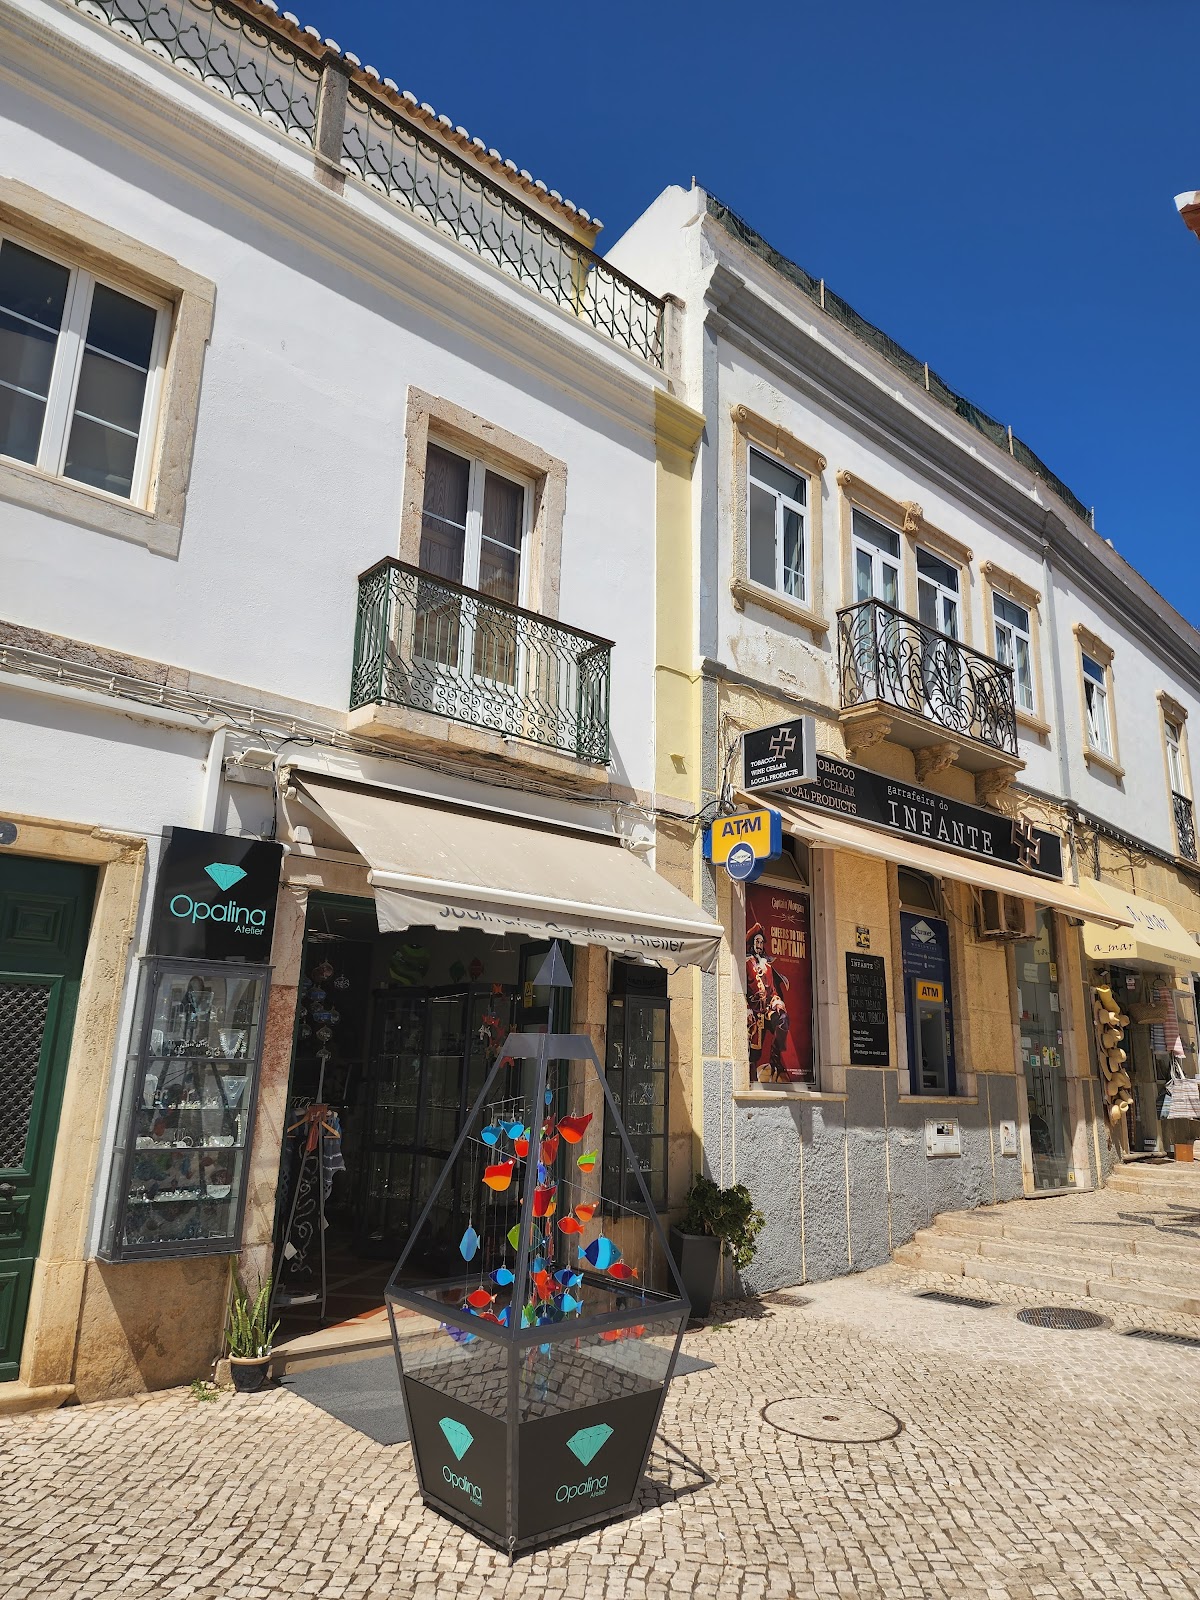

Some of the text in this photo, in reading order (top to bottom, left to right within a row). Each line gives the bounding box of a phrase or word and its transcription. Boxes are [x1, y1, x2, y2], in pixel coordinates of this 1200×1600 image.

[751, 756, 776, 767] TOBACCO
[751, 762, 787, 776] WINE CELLAR
[817, 760, 855, 780] OBACCO
[751, 769, 798, 785] LOCAL PRODUCTS
[823, 778, 855, 797] CELLAR
[782, 786, 857, 813] OCAL PRODUCTS
[887, 785, 949, 811] garrafeira do
[722, 816, 761, 838] ATM
[887, 800, 994, 855] INFANTE
[170, 894, 267, 926] Opalina
[234, 924, 264, 936] Atelier
[771, 926, 805, 942] CHEERS TO THE
[771, 937, 806, 959] CAPTAIN
[851, 960, 874, 970] INFANTE
[921, 986, 939, 998] ATM
[442, 1465, 482, 1501] Opalina
[556, 1474, 608, 1503] Opalina
